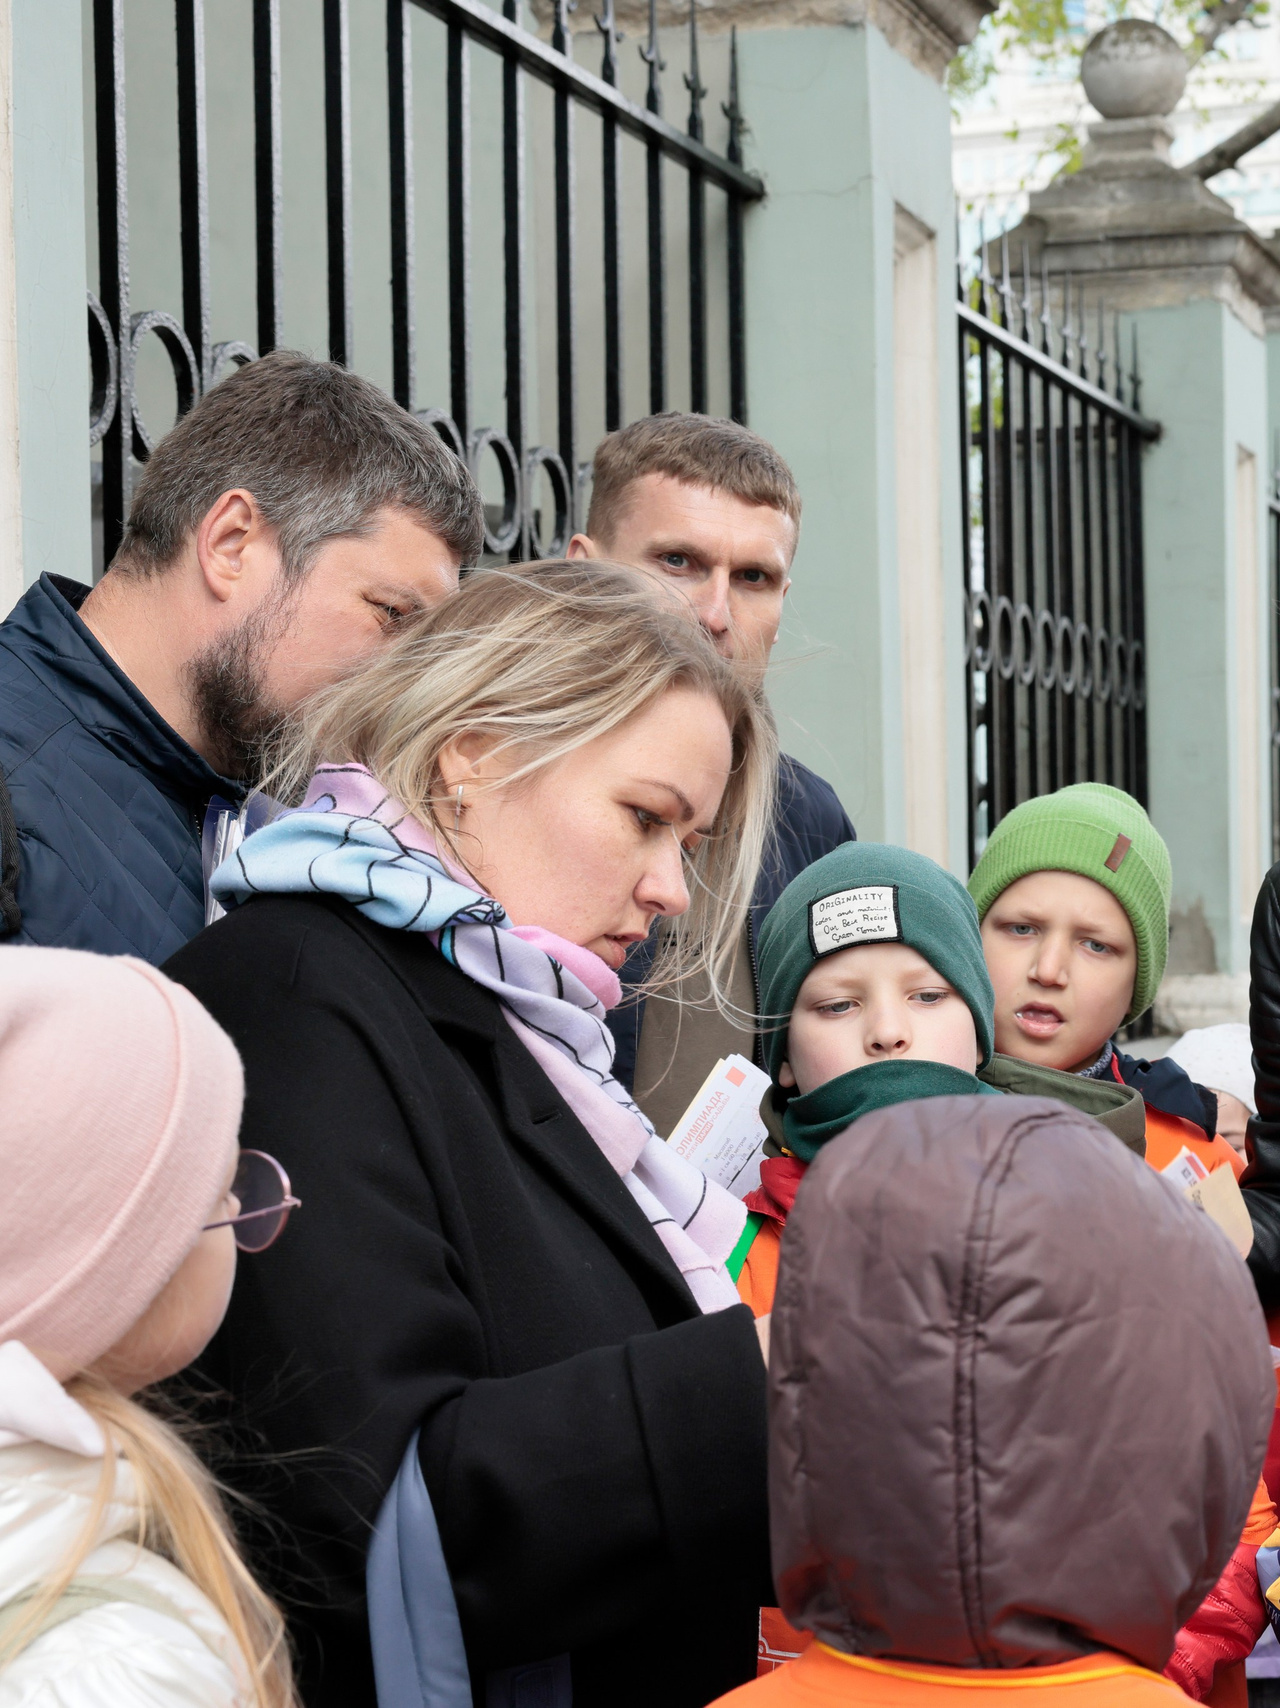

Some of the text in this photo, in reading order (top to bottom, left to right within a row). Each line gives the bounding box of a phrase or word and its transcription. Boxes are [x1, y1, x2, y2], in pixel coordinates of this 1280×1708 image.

[815, 916, 832, 927] color
[837, 909, 854, 918] and
[823, 925, 840, 935] Our
[863, 914, 888, 922] Recipe
[856, 926, 885, 935] Tomato
[676, 1091, 725, 1156] ОЛИМПИАДА
